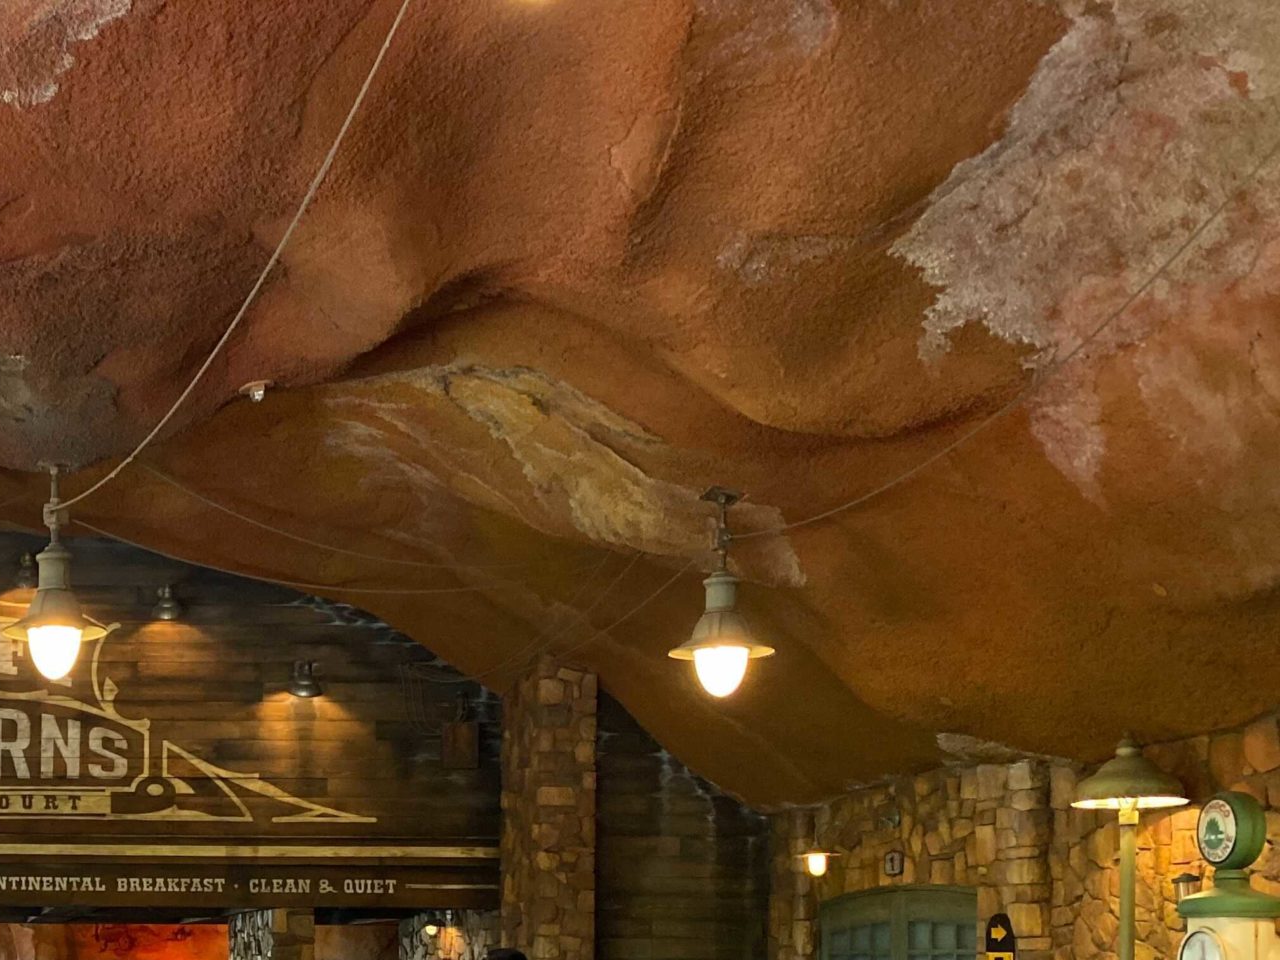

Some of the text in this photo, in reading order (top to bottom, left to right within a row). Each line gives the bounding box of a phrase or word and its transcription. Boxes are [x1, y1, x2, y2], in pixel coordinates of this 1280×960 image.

[116, 877, 226, 893] BREAKFAST
[248, 878, 311, 894] CLEAN
[318, 878, 338, 894] &
[343, 878, 397, 894] QUIET
